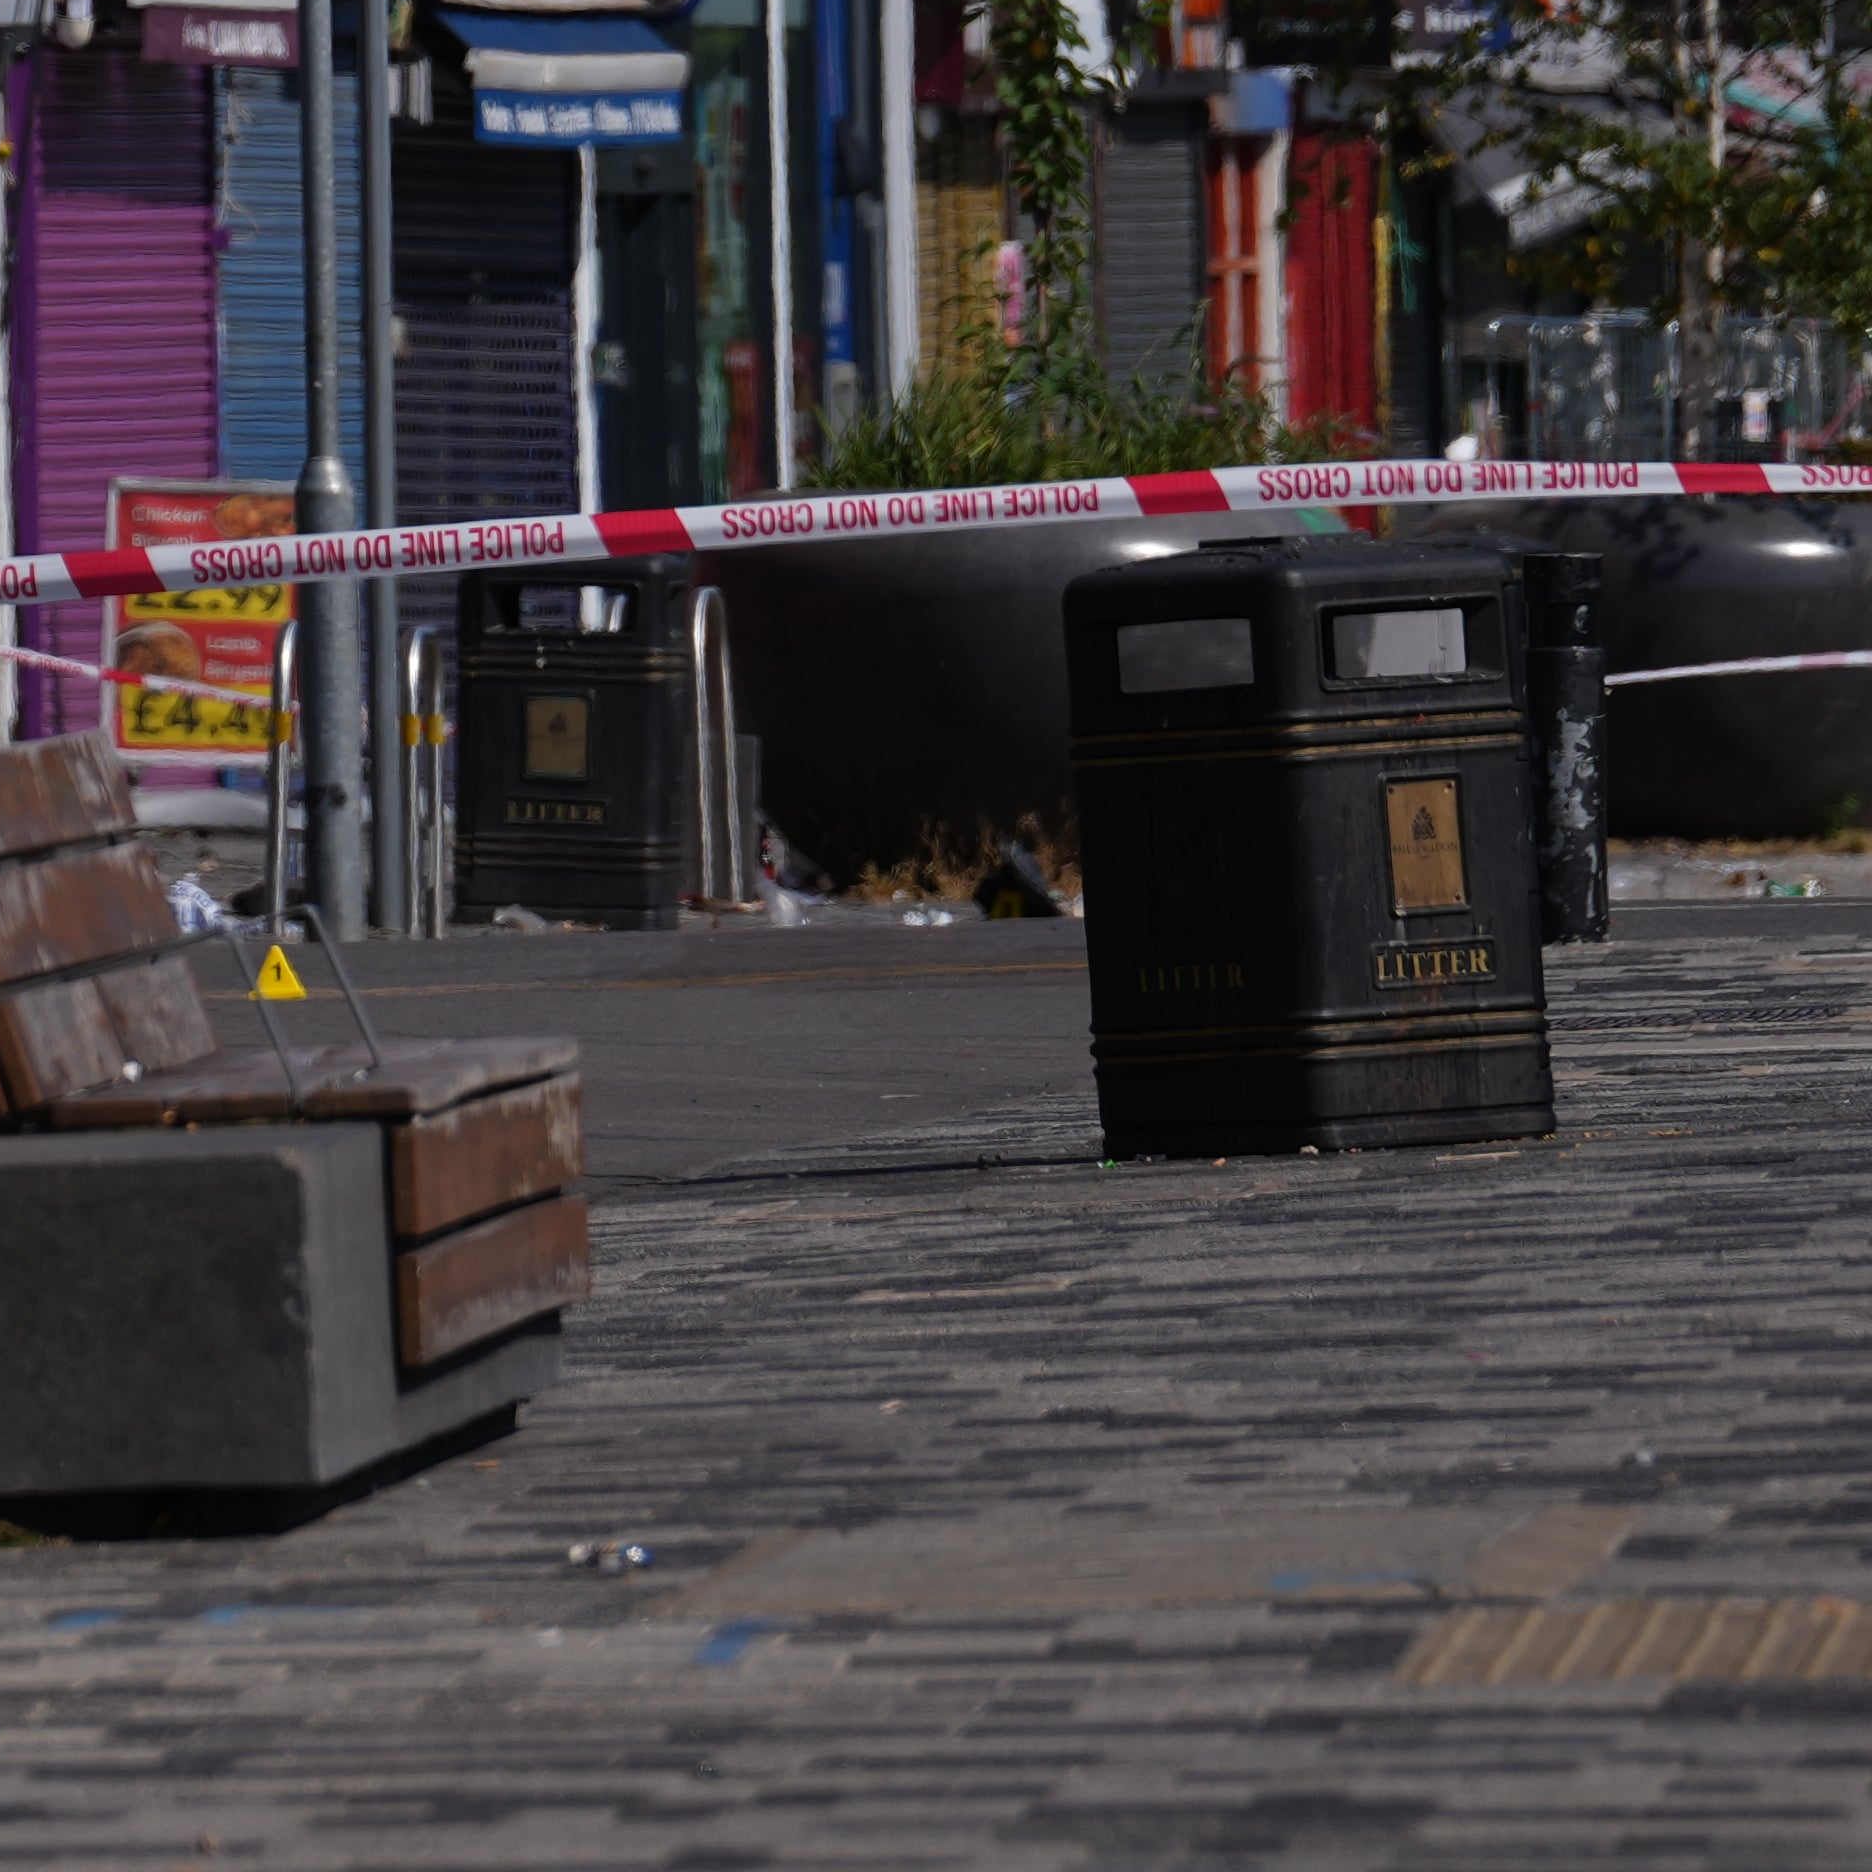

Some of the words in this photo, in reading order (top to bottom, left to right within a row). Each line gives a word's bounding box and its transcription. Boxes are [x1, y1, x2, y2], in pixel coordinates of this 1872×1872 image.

[1258, 468, 1352, 502] CROSS
[1360, 465, 1415, 498] NOT
[1423, 465, 1465, 495] DO
[1473, 463, 1530, 492] LINE
[1539, 462, 1639, 490] POLICE
[1801, 466, 1872, 486] ROSS
[132, 505, 206, 524] Chicken
[822, 498, 879, 531] NOT
[886, 495, 926, 526] DO
[933, 491, 994, 524] LINE
[999, 486, 1099, 516] POLICE
[721, 504, 815, 540] CROSS
[290, 538, 347, 576] NOT
[353, 535, 393, 571] DO
[400, 527, 460, 568] LINE
[465, 520, 565, 562] POLICE
[190, 543, 284, 584] CROSS
[272, 960, 283, 982] 1
[1139, 964, 1246, 994] LITTER
[1377, 948, 1491, 981] LITTER
